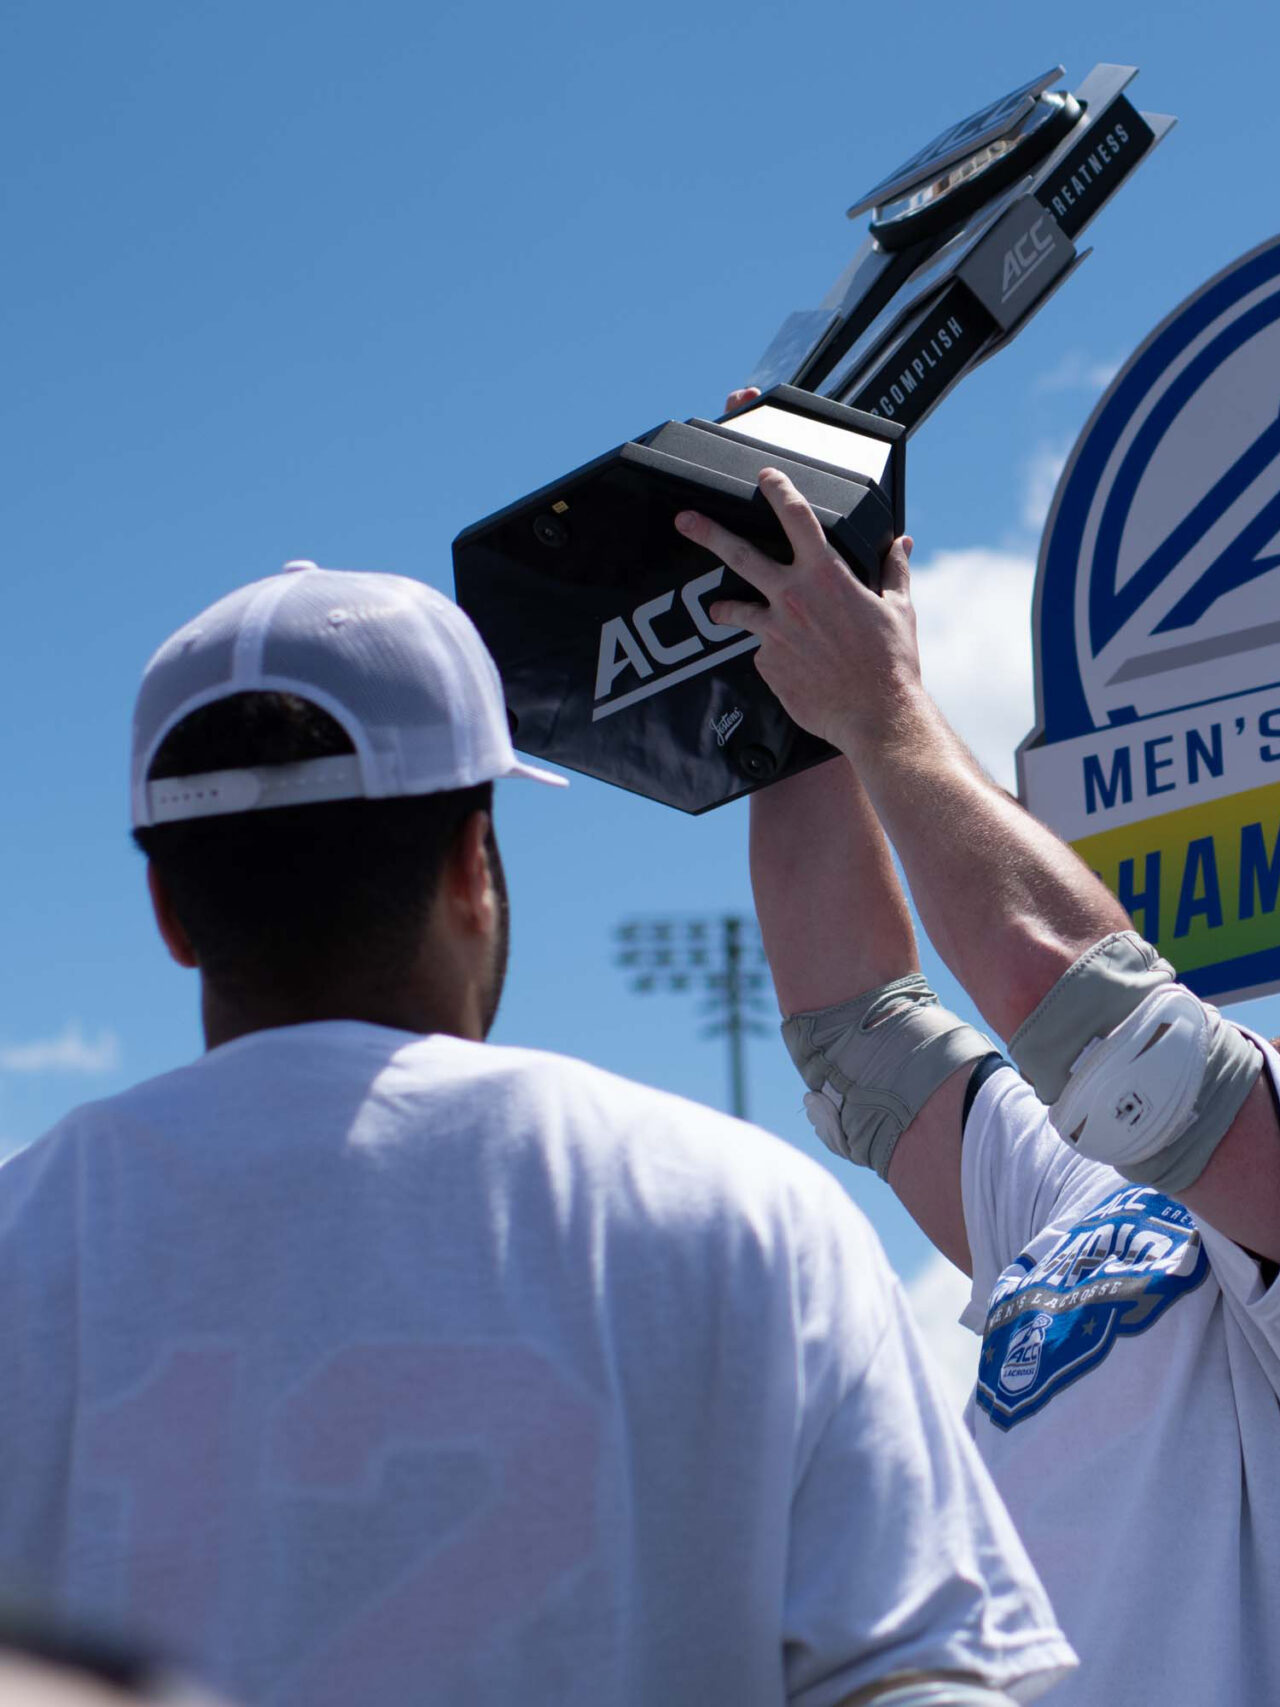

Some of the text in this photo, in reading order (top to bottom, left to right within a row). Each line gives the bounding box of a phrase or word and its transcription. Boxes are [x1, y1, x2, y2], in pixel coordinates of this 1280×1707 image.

[1001, 219, 1054, 293] ACC
[870, 316, 963, 416] COMPLISH
[594, 565, 747, 701] ACC
